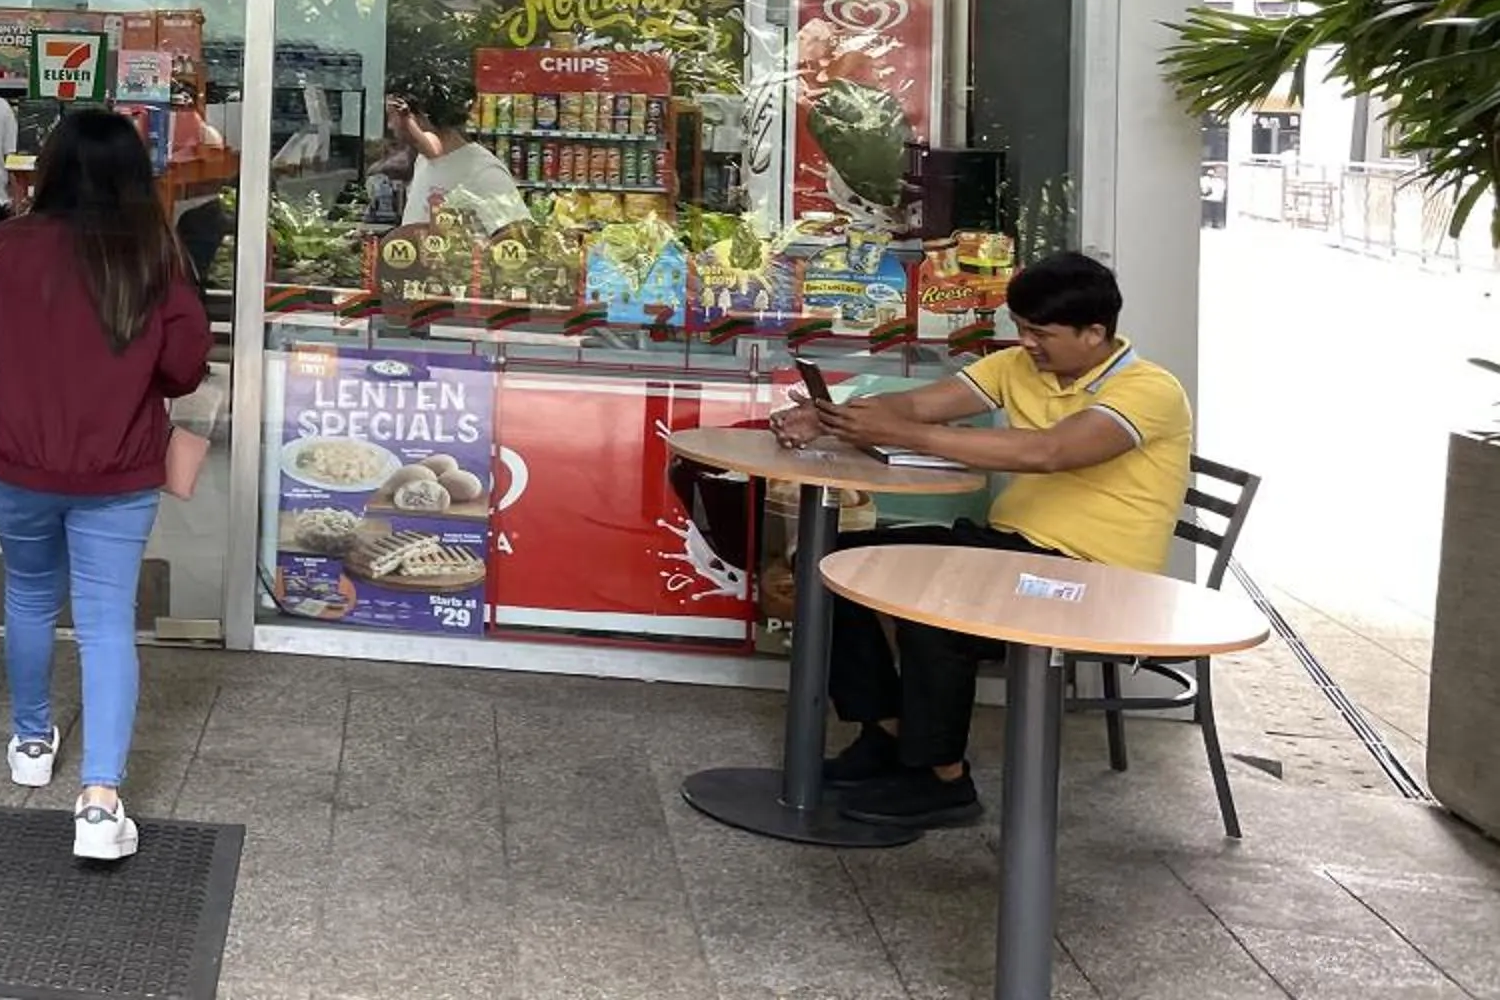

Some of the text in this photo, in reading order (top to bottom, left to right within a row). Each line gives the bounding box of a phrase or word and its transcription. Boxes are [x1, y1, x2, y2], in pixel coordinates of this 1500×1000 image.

[539, 56, 610, 73] CHIPS
[314, 379, 466, 411] LENTEN
[297, 409, 480, 443] SPECIALS
